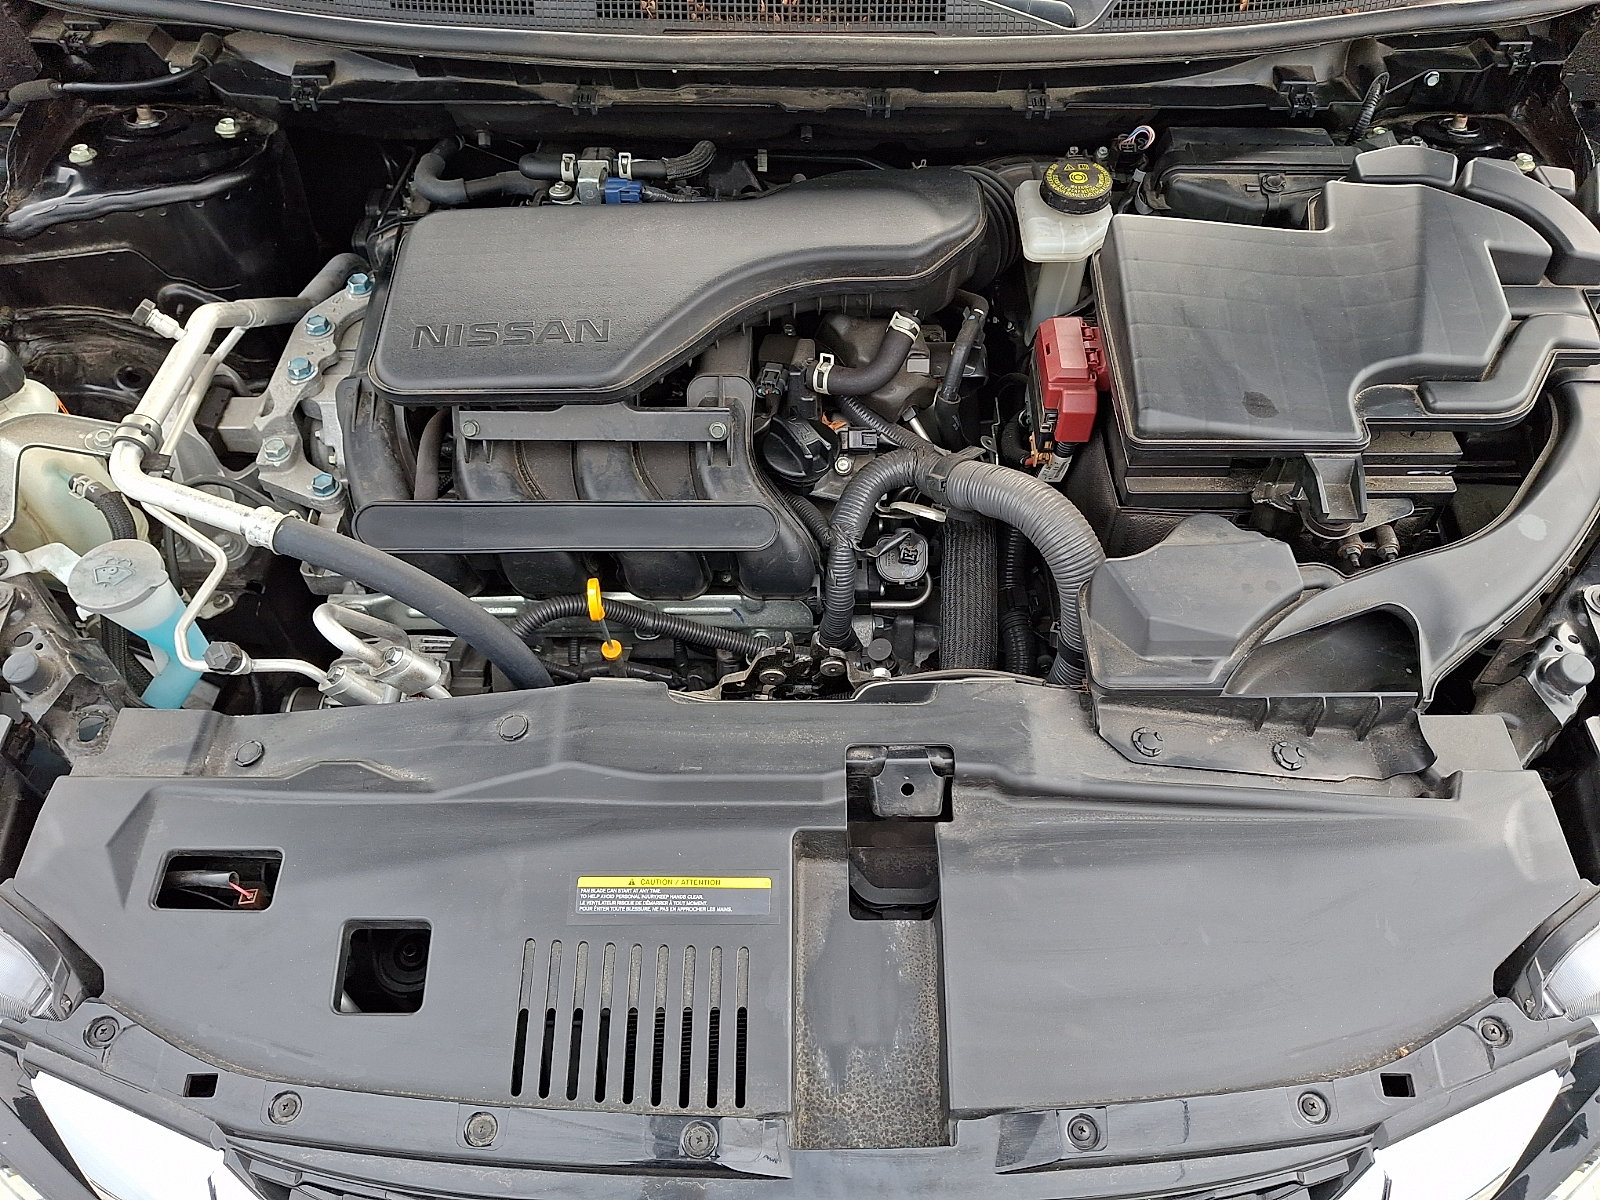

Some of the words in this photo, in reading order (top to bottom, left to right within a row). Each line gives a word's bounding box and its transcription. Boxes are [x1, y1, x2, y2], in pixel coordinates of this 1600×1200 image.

[411, 319, 610, 350] NISSAN
[640, 878, 673, 886] CAUTION
[680, 878, 721, 886] ATTENTION
